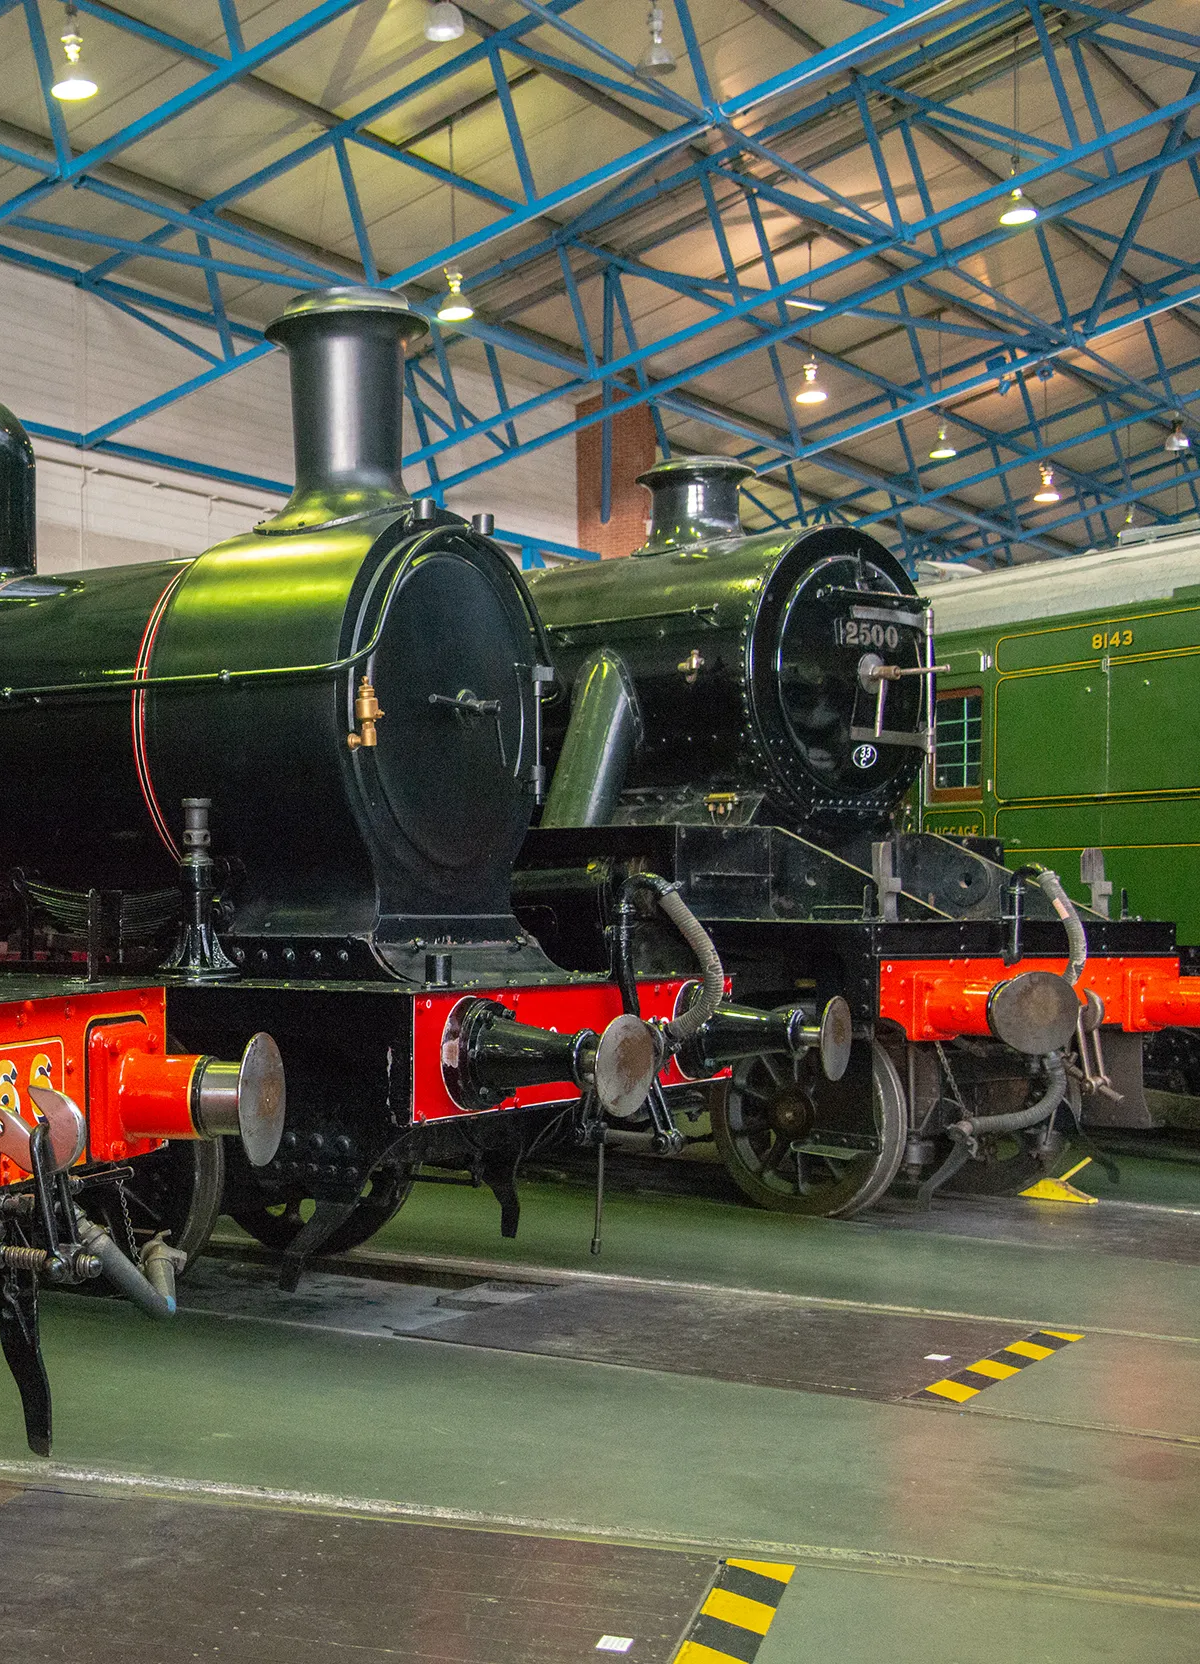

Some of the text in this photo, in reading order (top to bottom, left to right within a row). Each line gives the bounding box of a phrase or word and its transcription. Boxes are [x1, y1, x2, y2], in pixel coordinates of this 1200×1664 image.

[845, 621, 899, 649] 2500
[1091, 629, 1133, 650] 8143
[860, 747, 871, 758] 33
